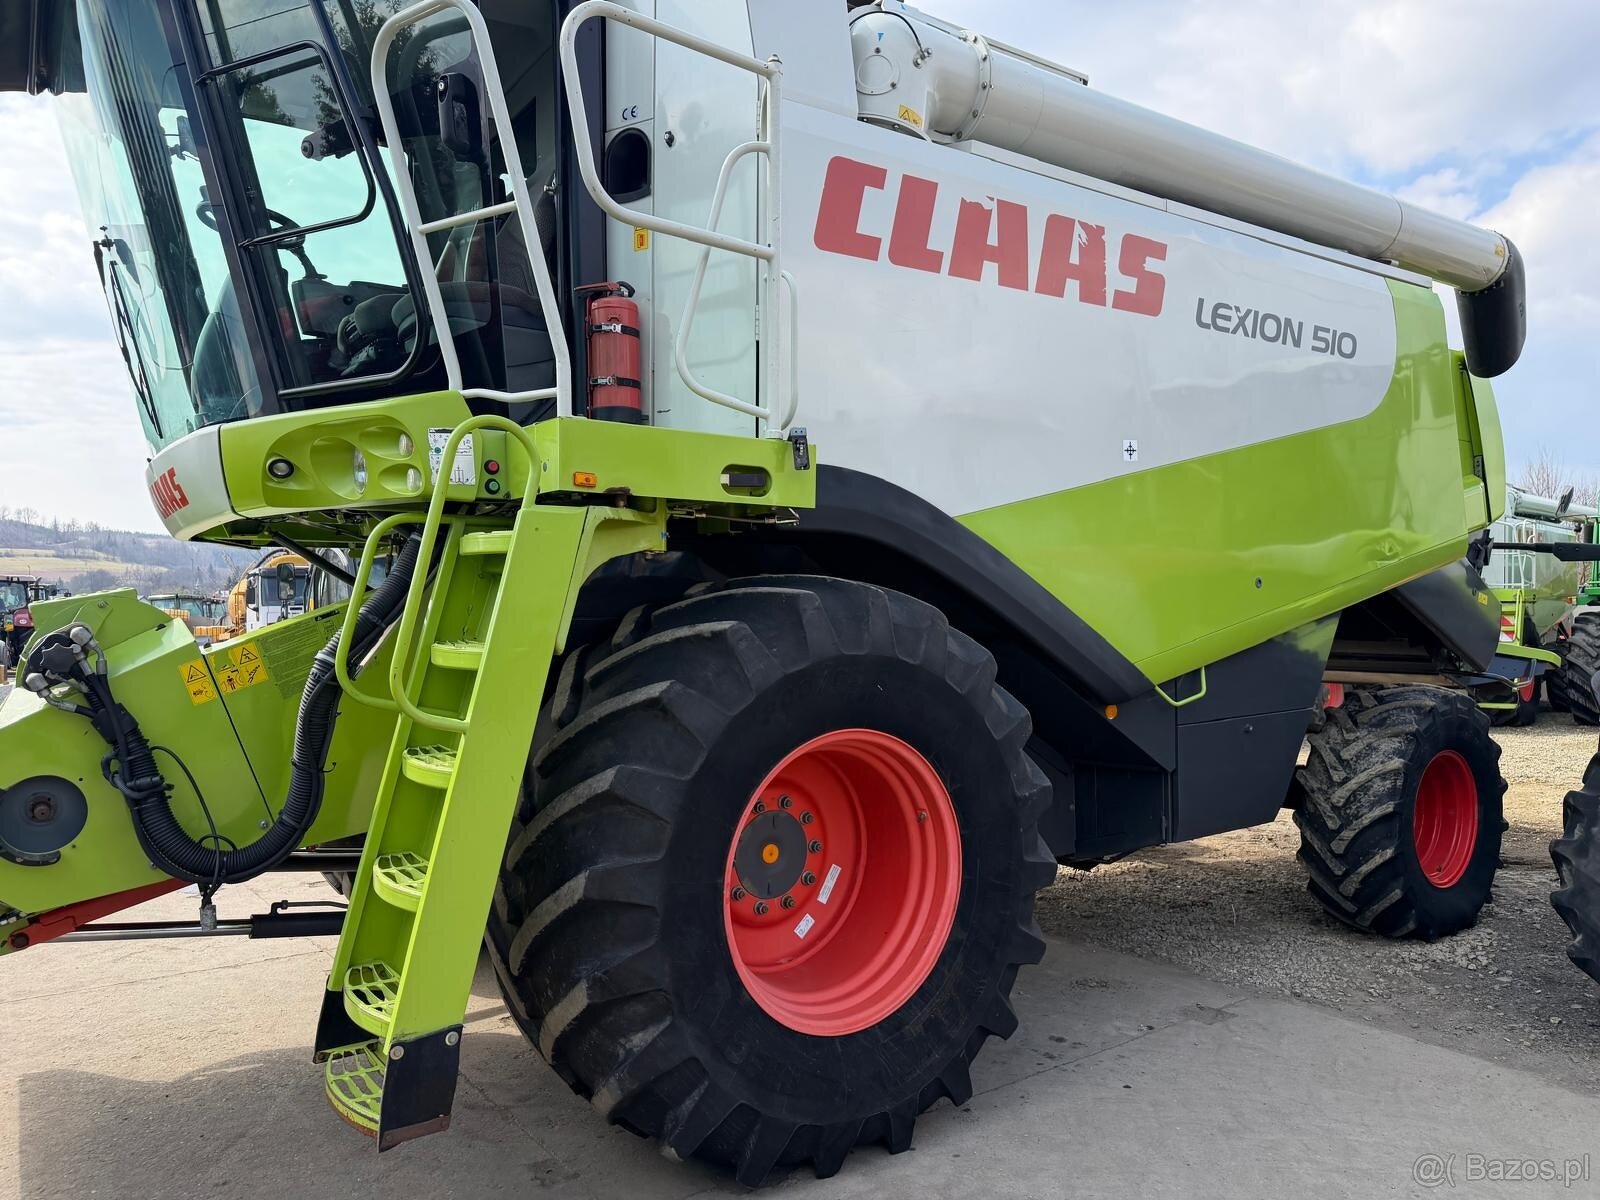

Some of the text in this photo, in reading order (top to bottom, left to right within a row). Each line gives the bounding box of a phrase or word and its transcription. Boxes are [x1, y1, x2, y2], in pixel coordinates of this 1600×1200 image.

[621, 104, 637, 121] CE
[814, 156, 1166, 315] CLAAS
[1195, 297, 1358, 359] LEXION 510
